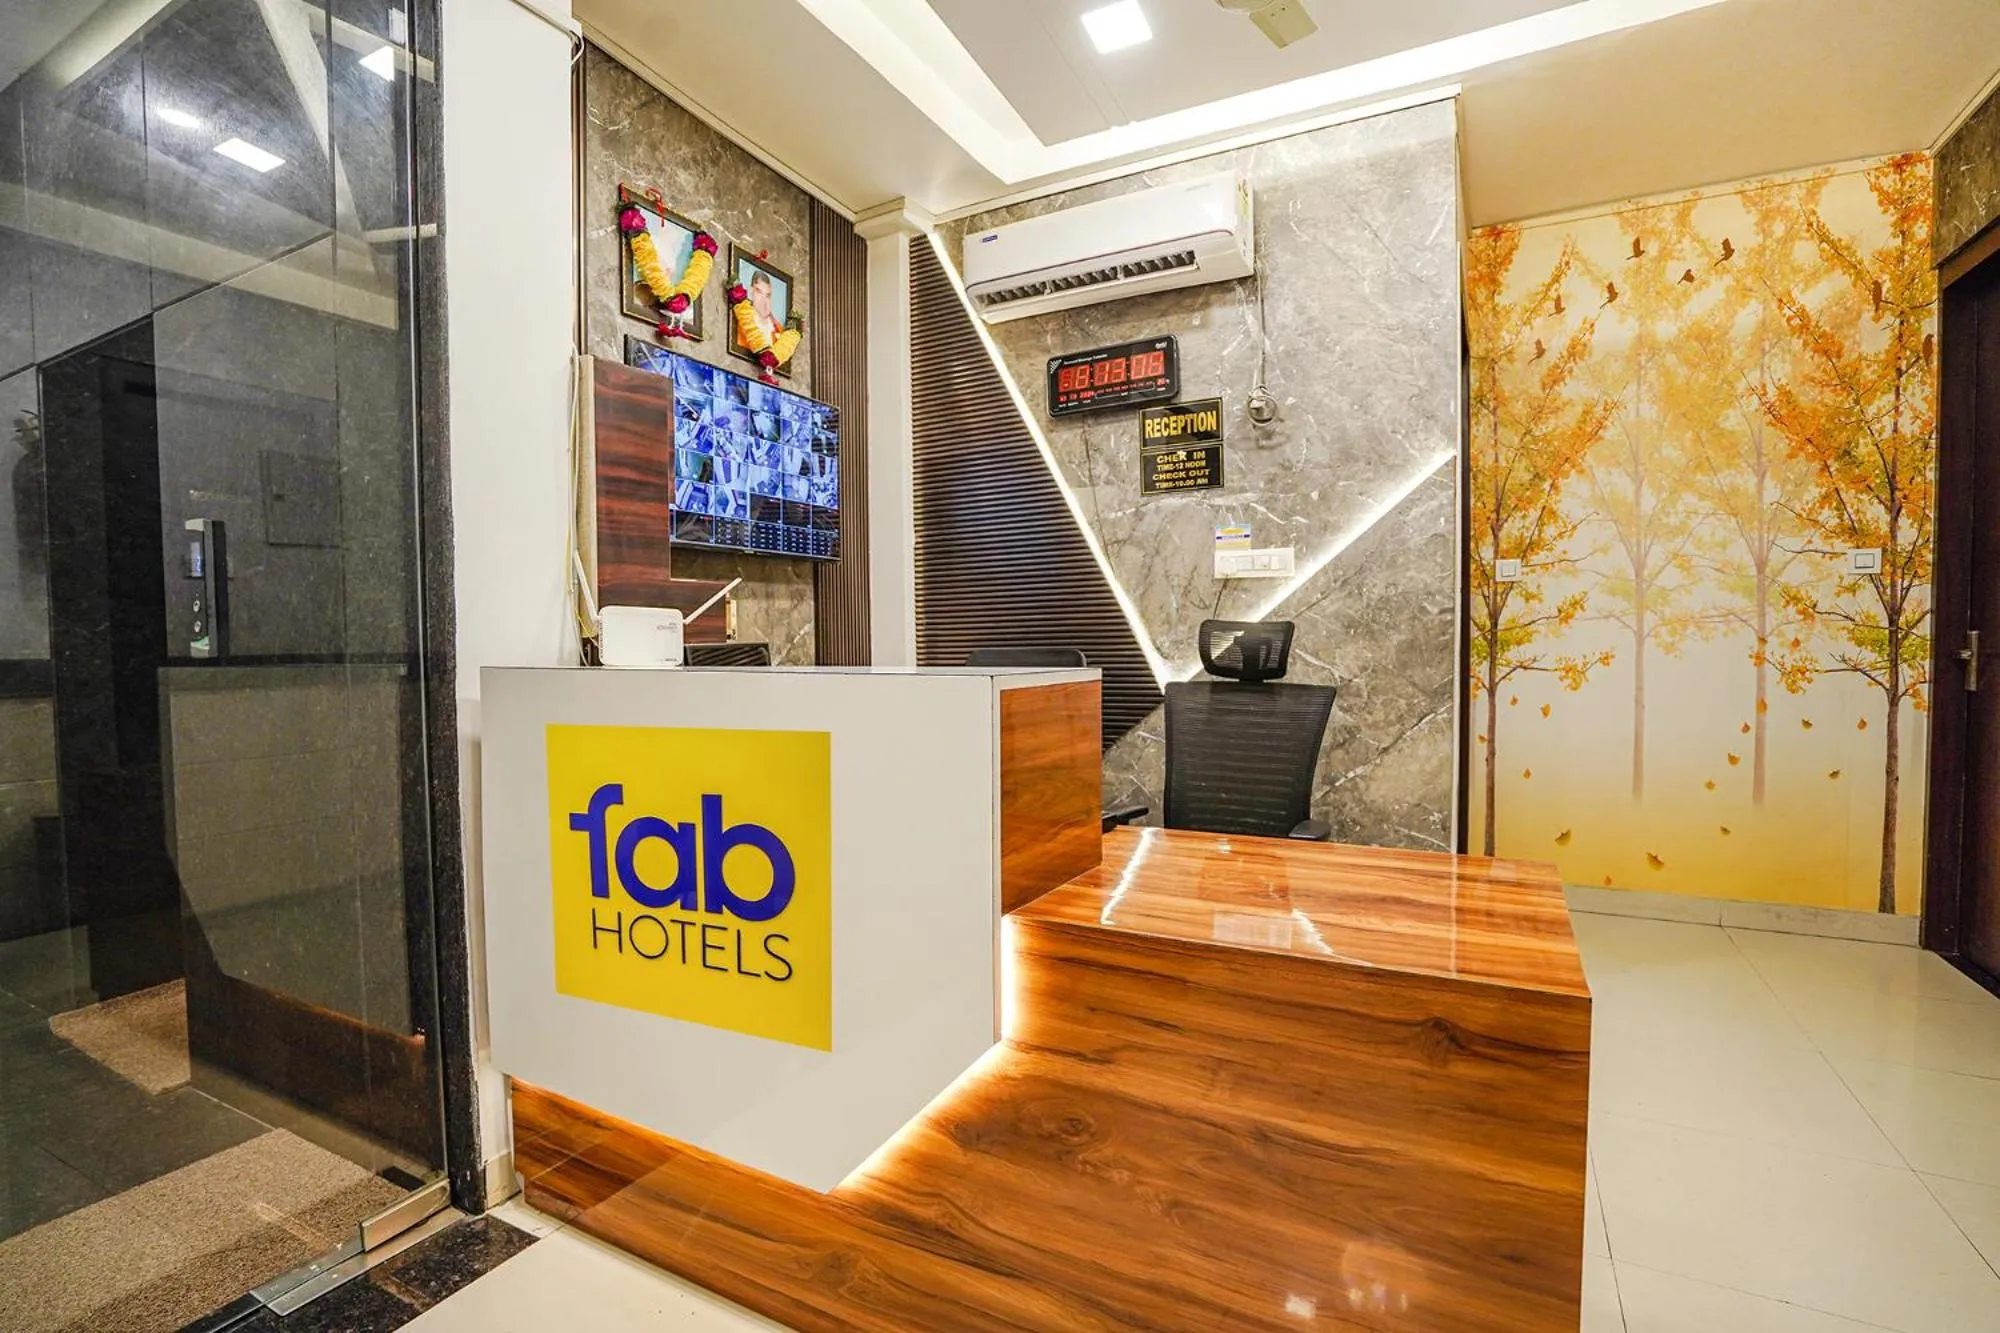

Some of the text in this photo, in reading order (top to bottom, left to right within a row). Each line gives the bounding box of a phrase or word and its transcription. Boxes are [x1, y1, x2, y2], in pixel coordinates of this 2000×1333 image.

[1144, 410, 1217, 439] RECEPTION
[1185, 460, 1206, 468] NOON
[1193, 450, 1206, 460] IN
[1152, 469, 1210, 481] CHECK OUT
[569, 784, 795, 922] fab
[592, 907, 793, 982] HOTELS
